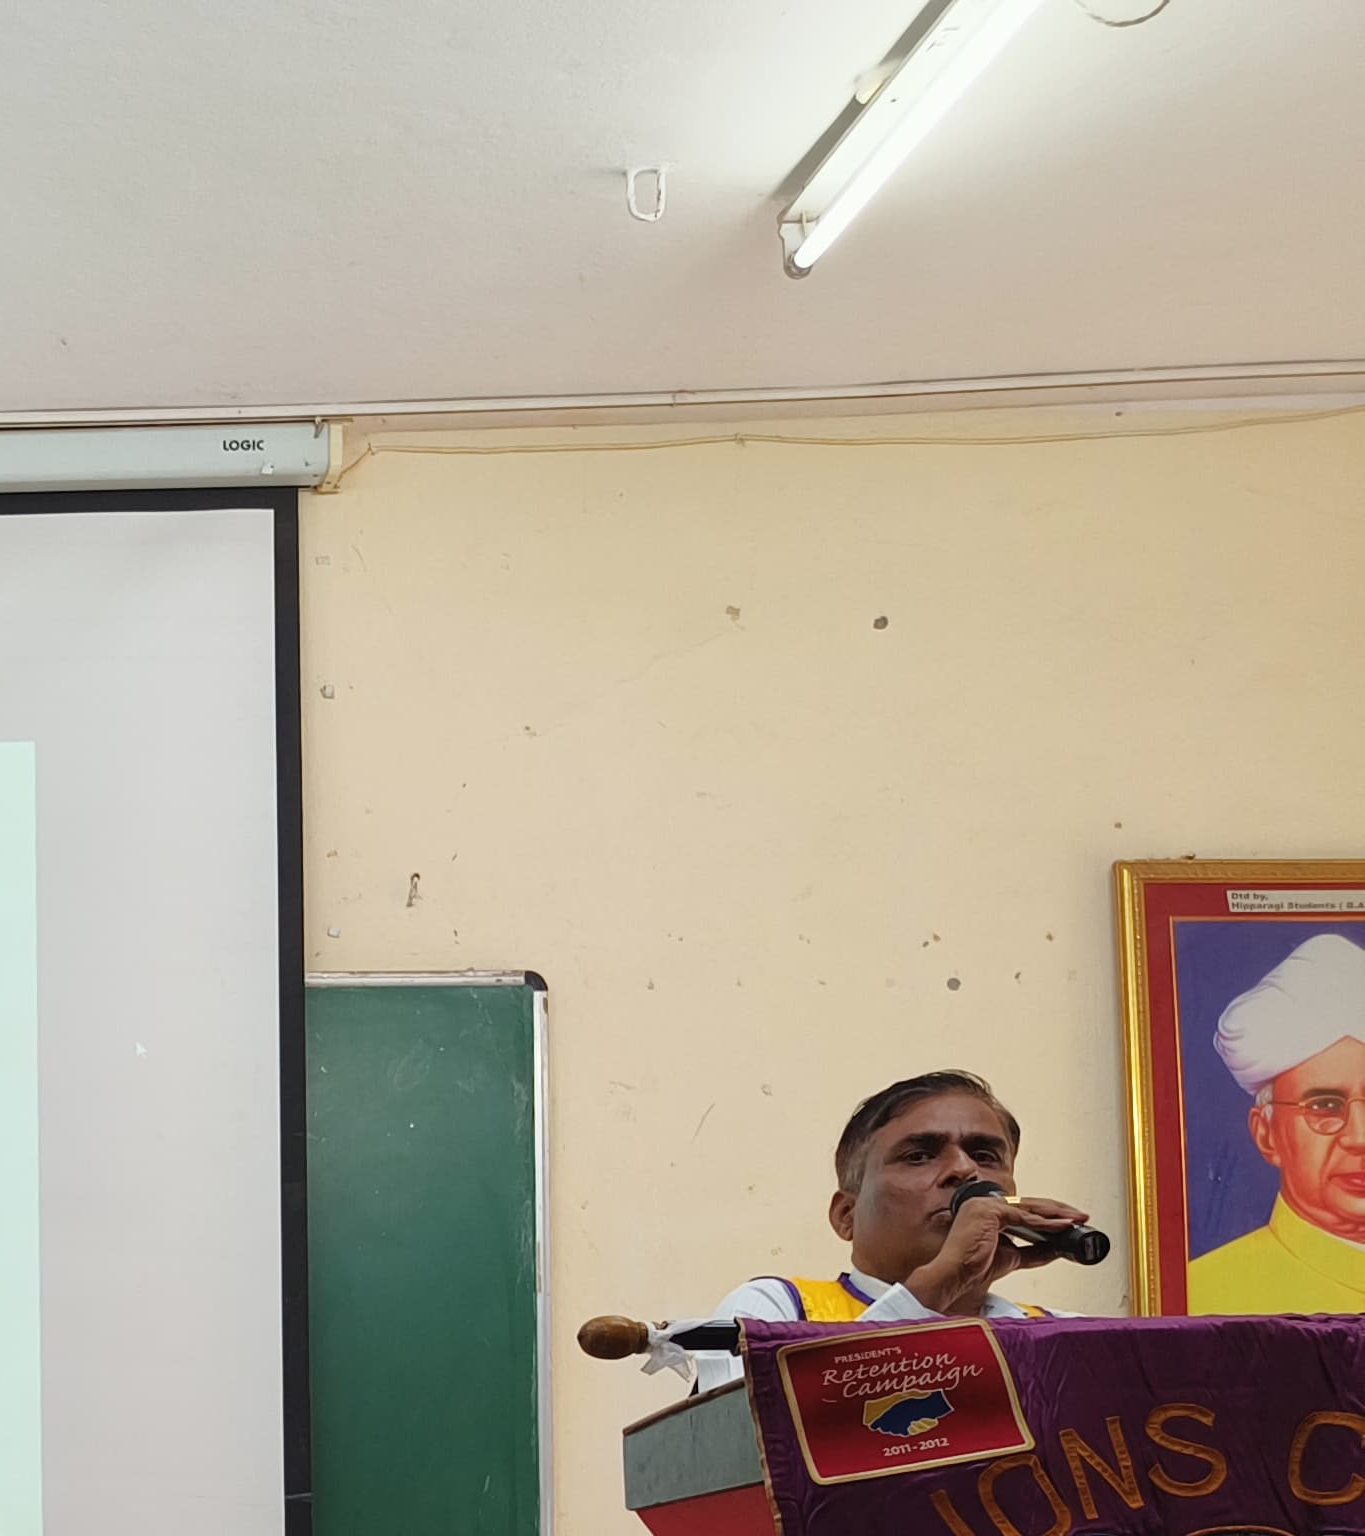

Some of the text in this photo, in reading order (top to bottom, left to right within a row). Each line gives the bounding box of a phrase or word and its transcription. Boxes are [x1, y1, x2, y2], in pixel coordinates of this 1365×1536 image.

[222, 439, 265, 451] LOGIC
[822, 1352, 957, 1386] Retention
[842, 1363, 984, 1398] Campaign
